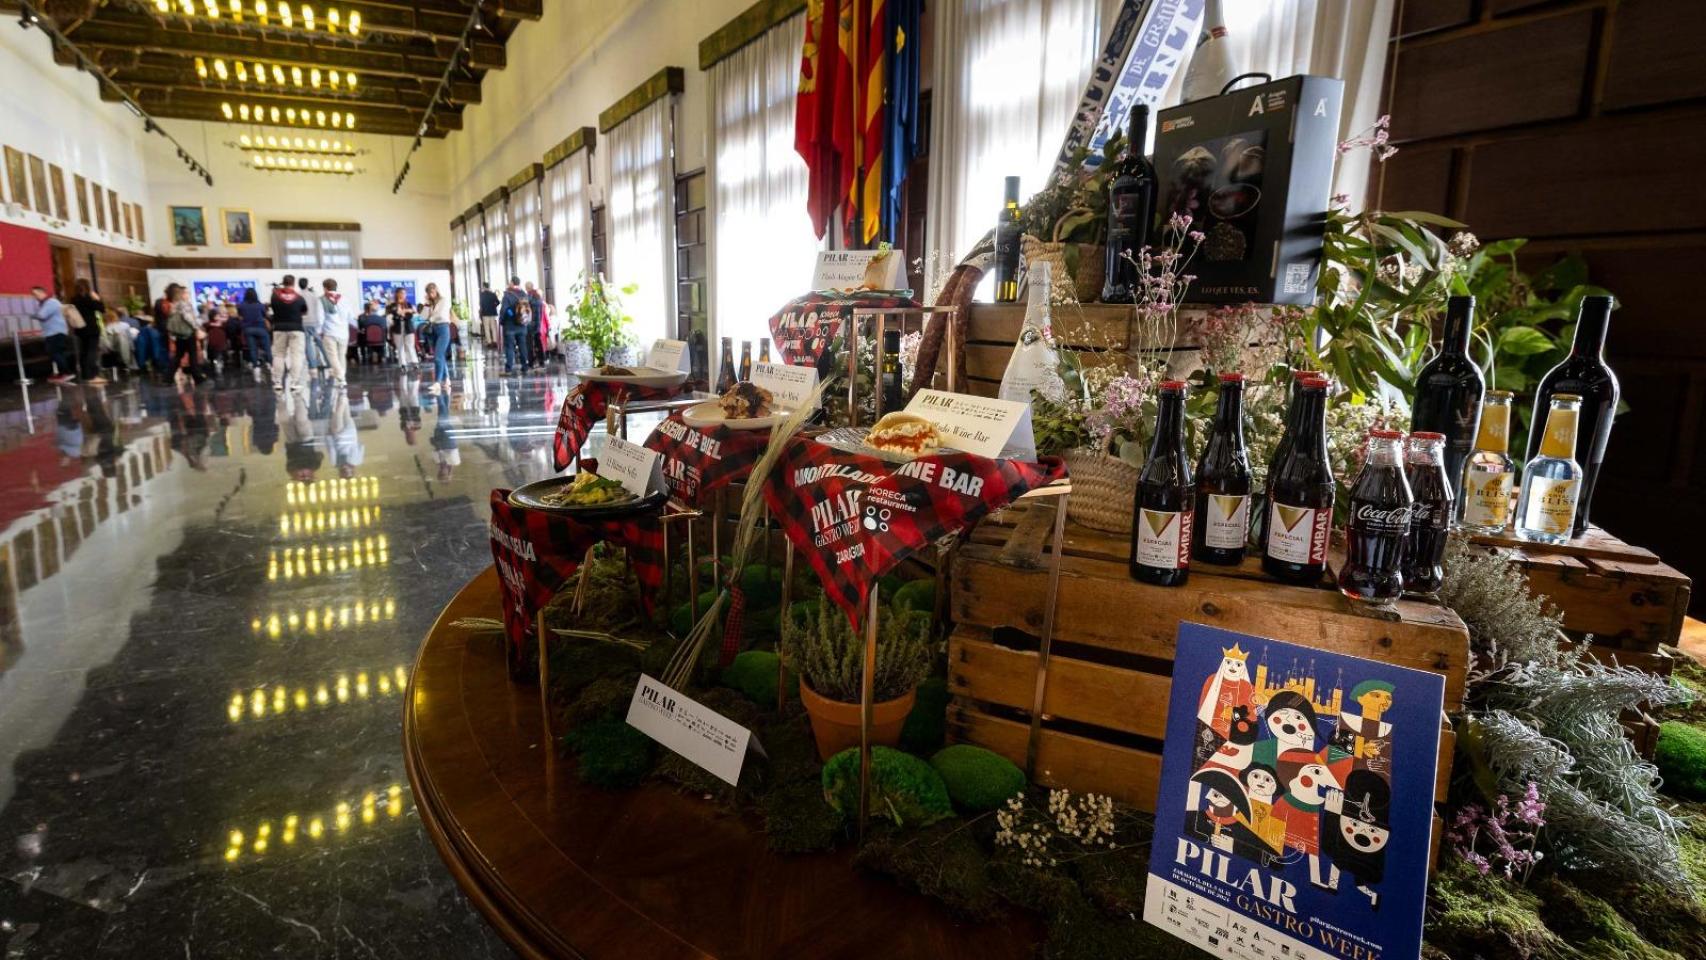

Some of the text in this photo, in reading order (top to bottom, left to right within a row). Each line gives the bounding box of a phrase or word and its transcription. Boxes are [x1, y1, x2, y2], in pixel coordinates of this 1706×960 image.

[823, 253, 849, 263] PILAR
[756, 364, 774, 376] PILAR
[921, 394, 954, 408] PILAR
[951, 423, 973, 440] Wine
[973, 430, 991, 443] Bar
[938, 466, 985, 498] BAR
[868, 486, 907, 502] HORECA
[866, 495, 917, 514] restaurantes
[815, 530, 843, 548] GASTRO
[1179, 512, 1193, 564] AMBAR
[1312, 511, 1329, 561] AMBAR
[641, 685, 677, 713] PILAR
[1175, 836, 1298, 914] PILAR
[1237, 894, 1314, 938] GASTRO
